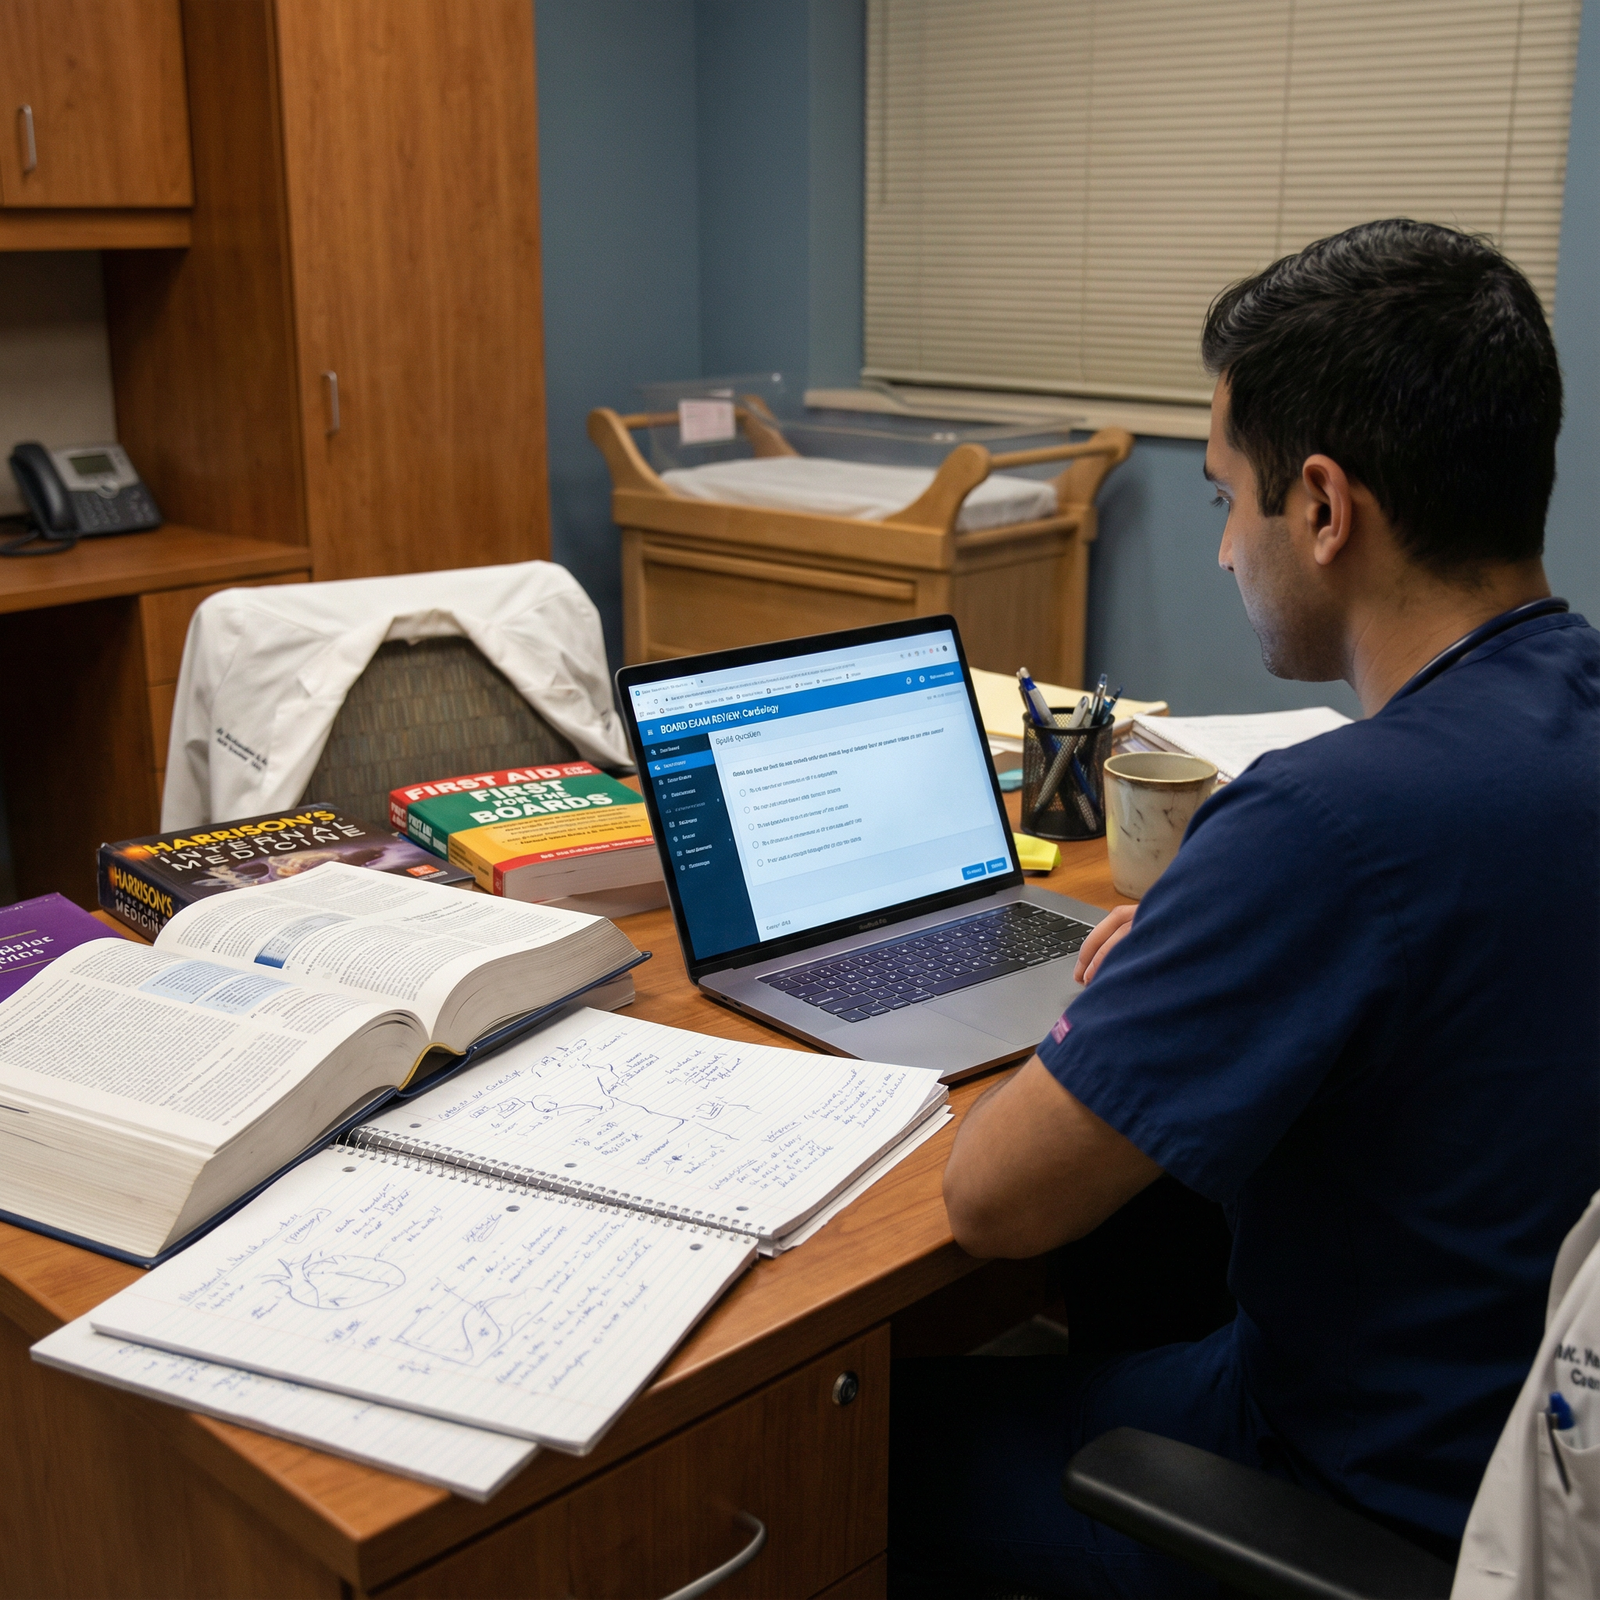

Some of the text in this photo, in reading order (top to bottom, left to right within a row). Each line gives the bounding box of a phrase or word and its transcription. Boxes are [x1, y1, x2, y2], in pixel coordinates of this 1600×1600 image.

[660, 722, 688, 735] BOARD
[404, 775, 497, 801] FIRST
[507, 767, 562, 784] AID
[468, 780, 566, 803] FIRST
[492, 791, 572, 808] FOR THE
[468, 793, 614, 824] BOARDS
[143, 810, 336, 856] HARRISON'S
[159, 821, 356, 864] INTERNAL
[171, 825, 366, 872] MEDICINE
[114, 865, 174, 918] HARRISON'S
[115, 898, 163, 935] MEDICIN
